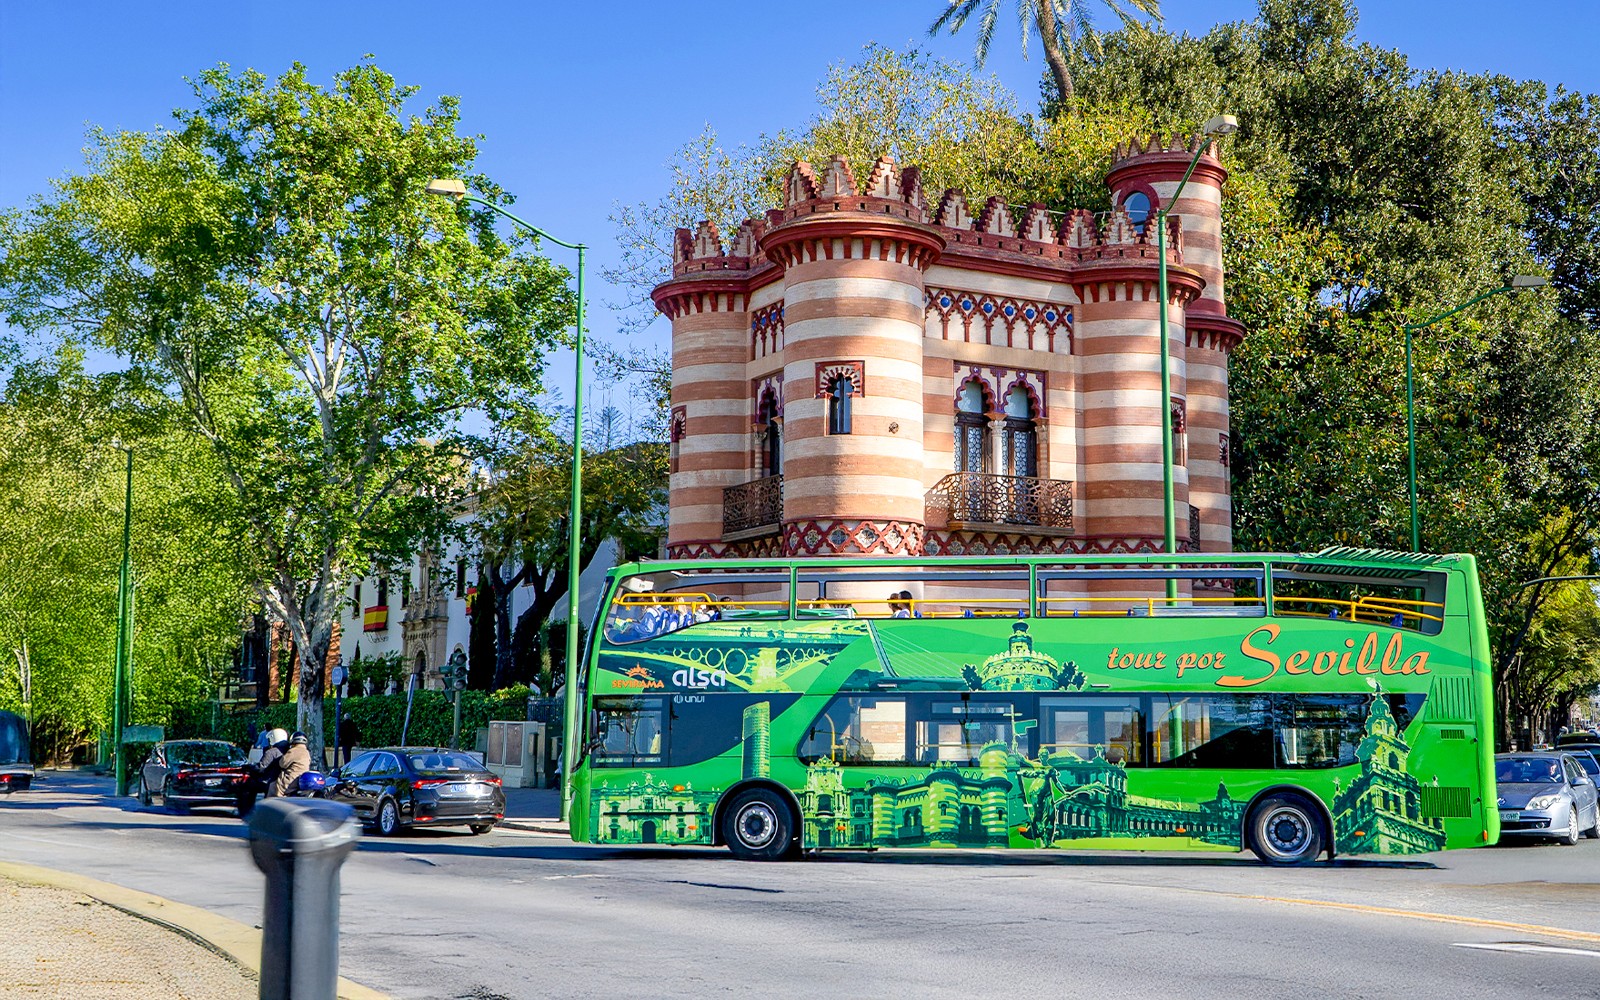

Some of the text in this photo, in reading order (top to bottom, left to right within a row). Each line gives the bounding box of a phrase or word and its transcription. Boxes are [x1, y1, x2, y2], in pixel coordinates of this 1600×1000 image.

[1107, 624, 1431, 687] tour por Sevilla
[612, 679, 665, 689] SEVIRAMA
[672, 667, 726, 687] alsa
